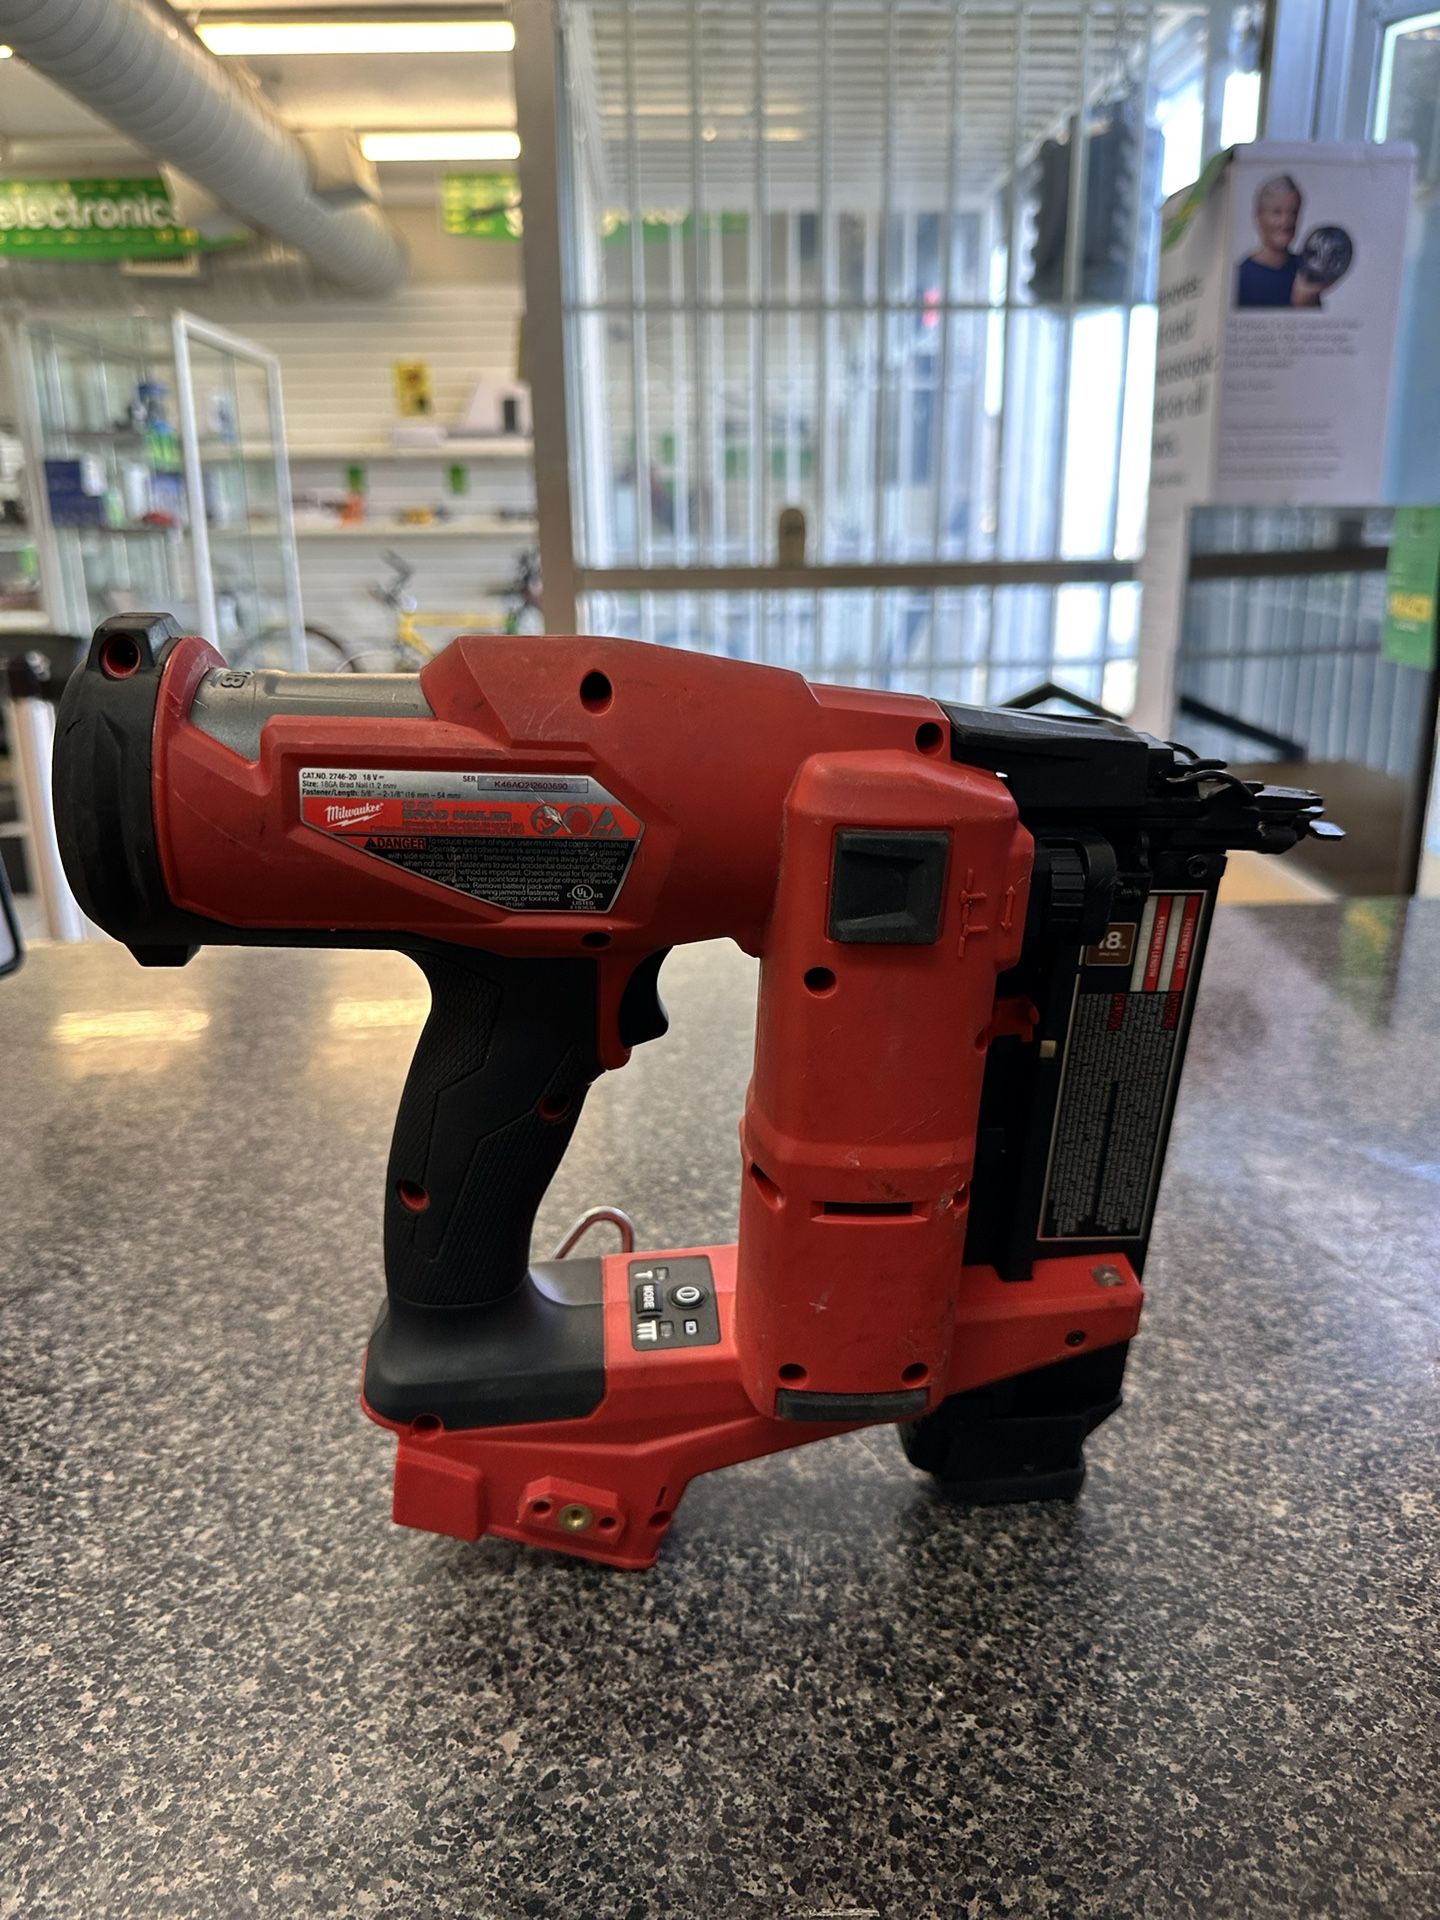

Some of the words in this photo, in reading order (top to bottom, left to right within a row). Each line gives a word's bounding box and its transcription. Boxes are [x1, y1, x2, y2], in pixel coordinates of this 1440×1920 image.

[329, 773, 356, 781] 2746-20
[302, 789, 360, 798] Fastener/Length:
[324, 802, 382, 823] Milwaukee
[377, 838, 426, 849] DANGER
